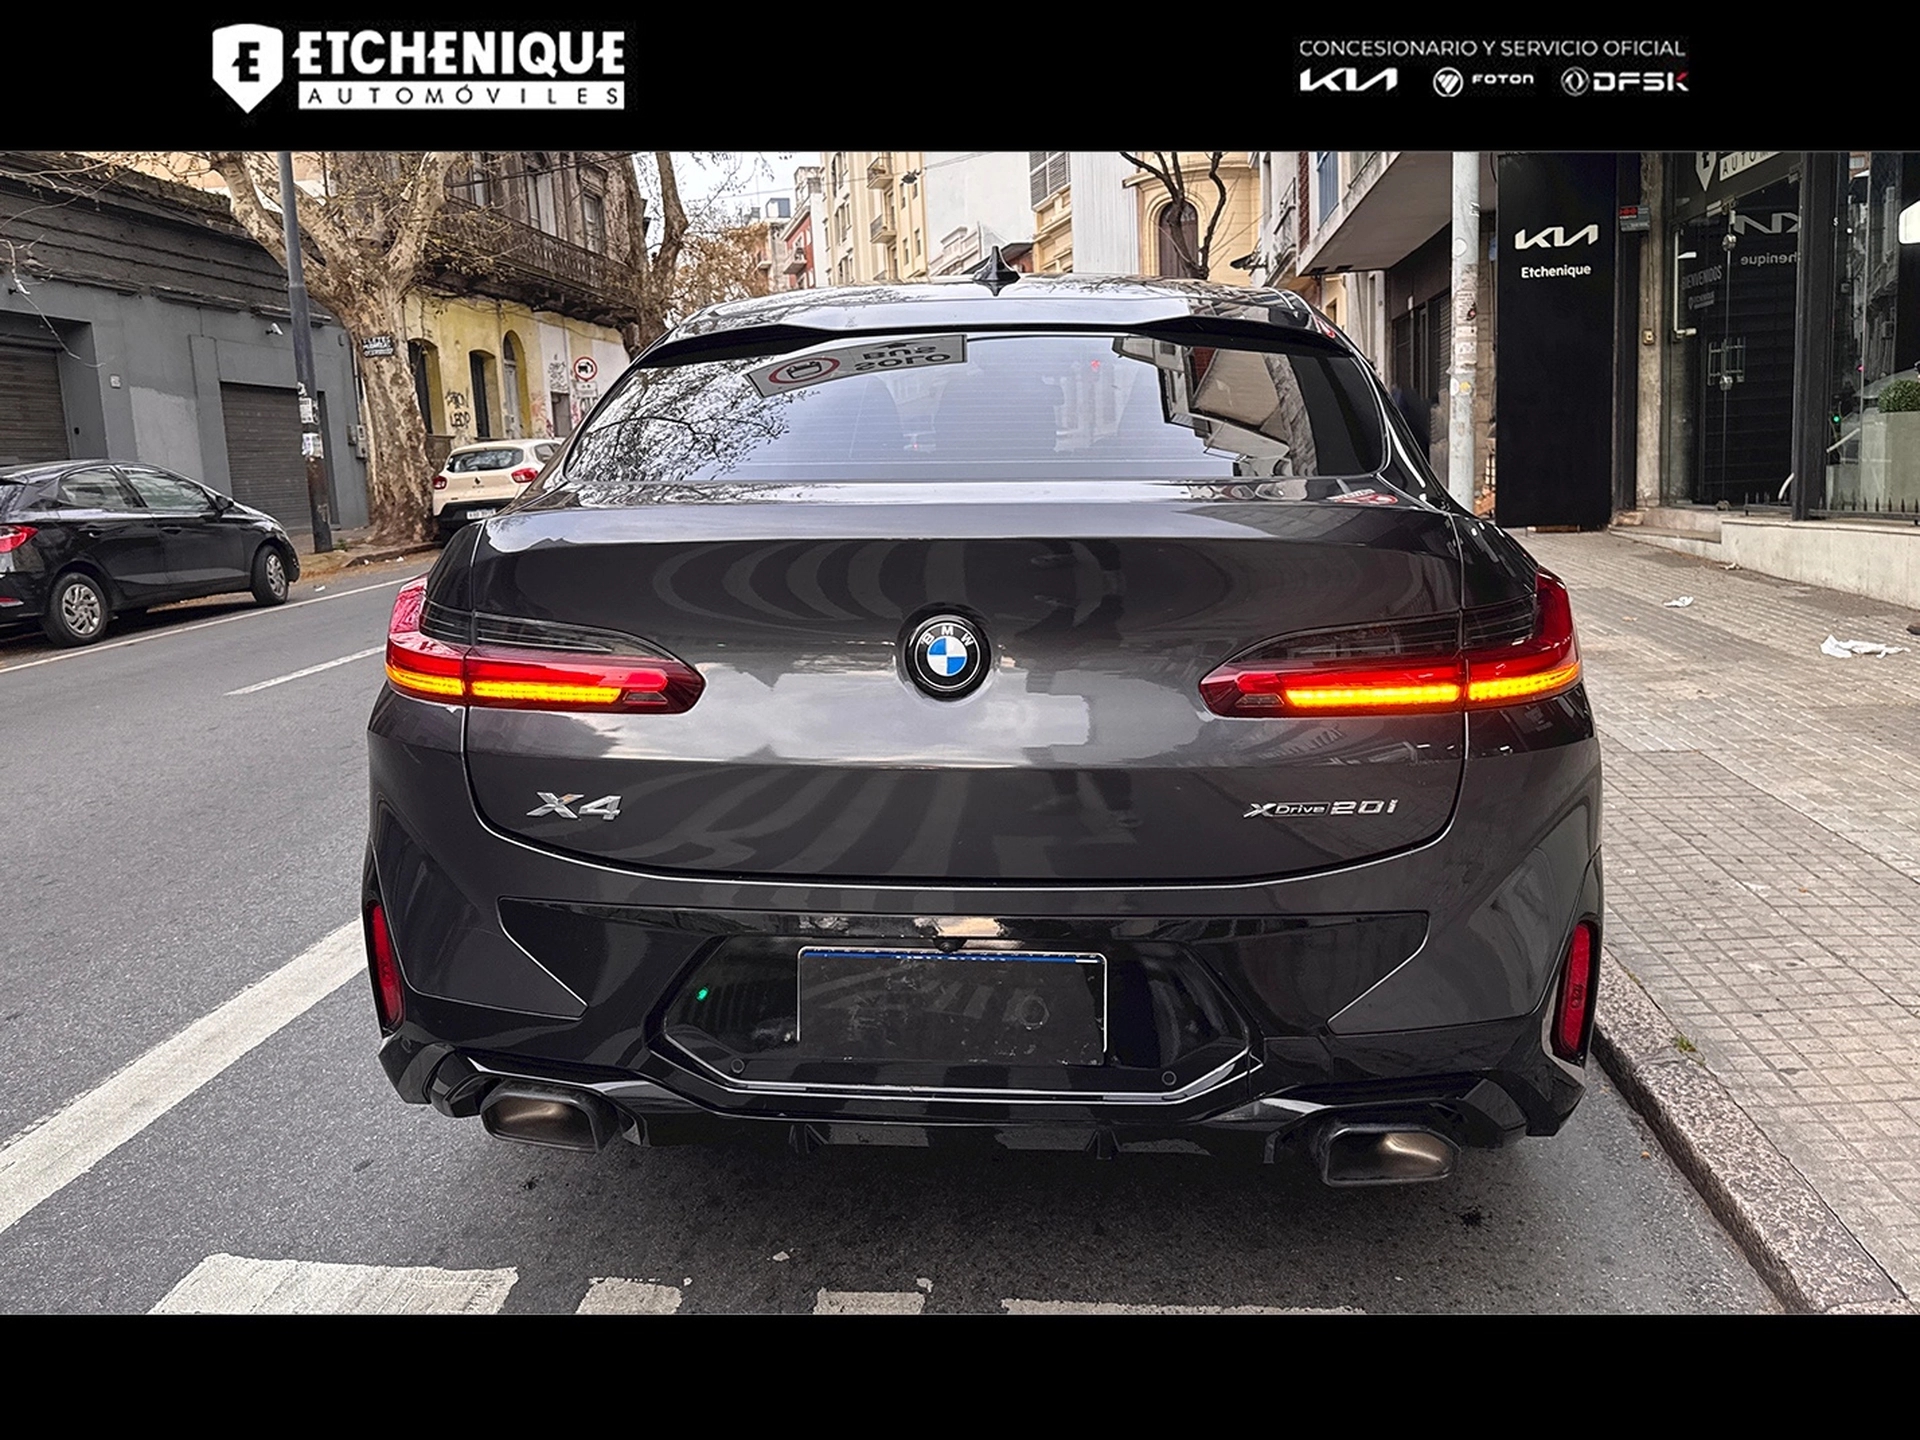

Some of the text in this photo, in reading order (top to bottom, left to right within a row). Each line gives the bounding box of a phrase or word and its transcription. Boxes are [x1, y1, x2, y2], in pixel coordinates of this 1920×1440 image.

[1514, 224, 1599, 250] KIA
[1521, 264, 1592, 278] Etchenique
[920, 625, 974, 647] BMW
[526, 791, 622, 820] X4
